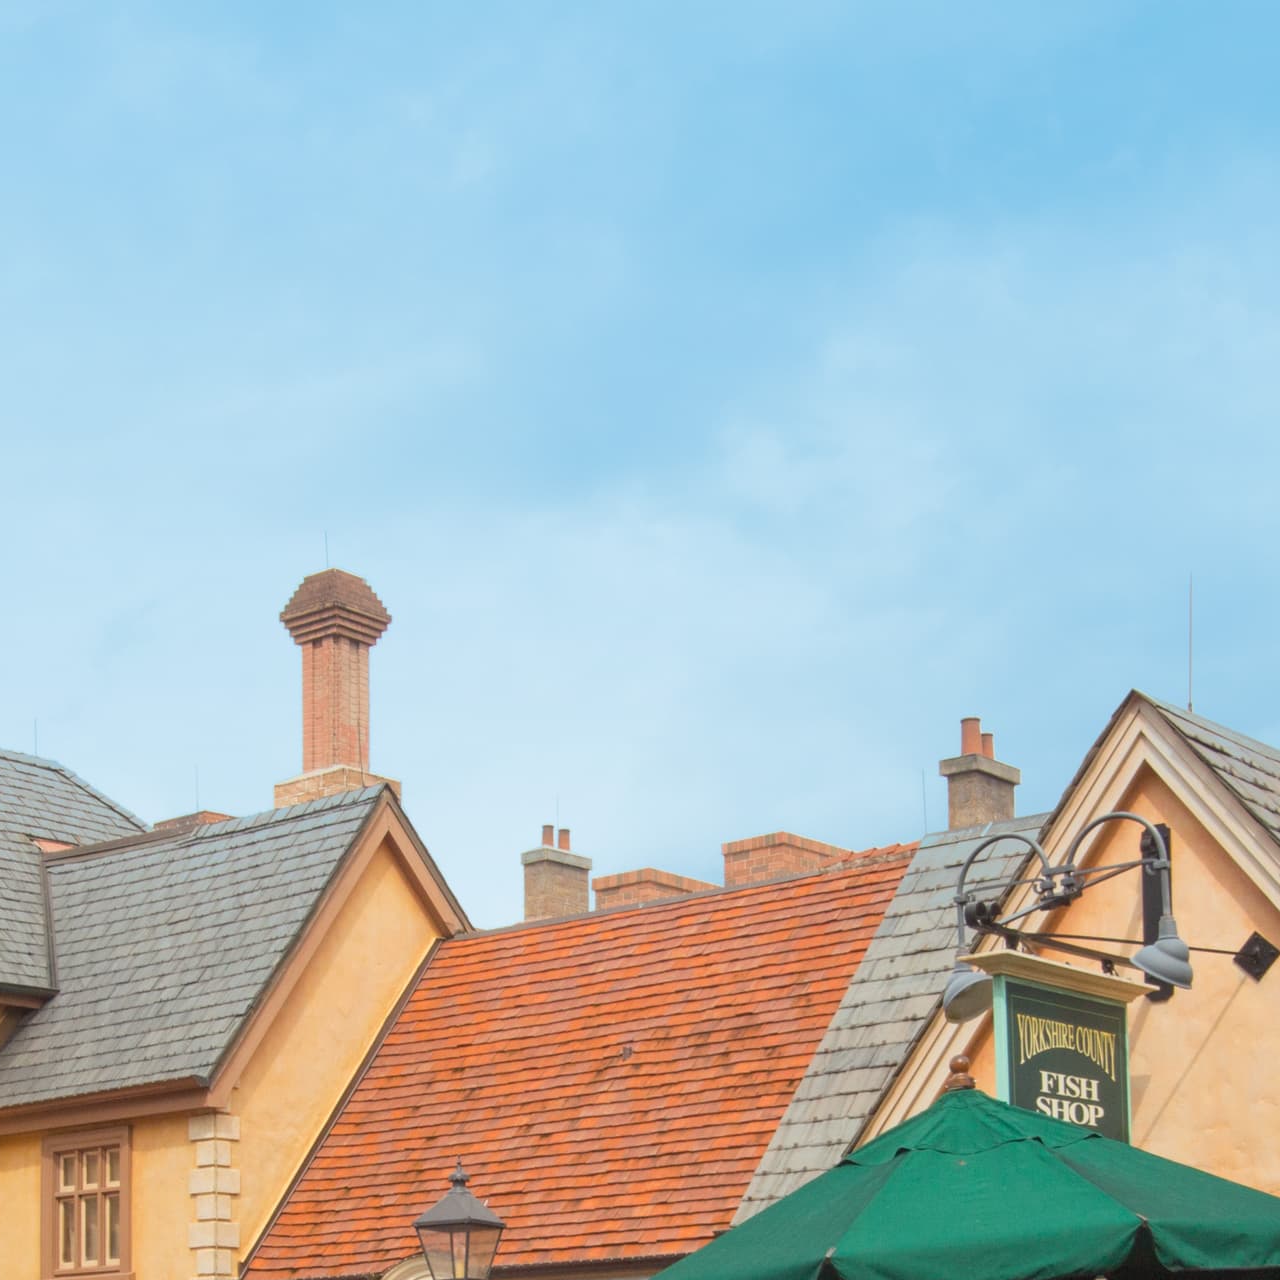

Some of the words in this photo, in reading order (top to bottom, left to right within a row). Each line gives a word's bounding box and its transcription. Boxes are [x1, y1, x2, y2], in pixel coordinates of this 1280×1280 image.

[1017, 1013, 1075, 1064] YORKSHIRE
[1076, 1026, 1116, 1082] COUNTY
[1039, 1070, 1100, 1101] FISH
[1036, 1096, 1105, 1127] SHOP
